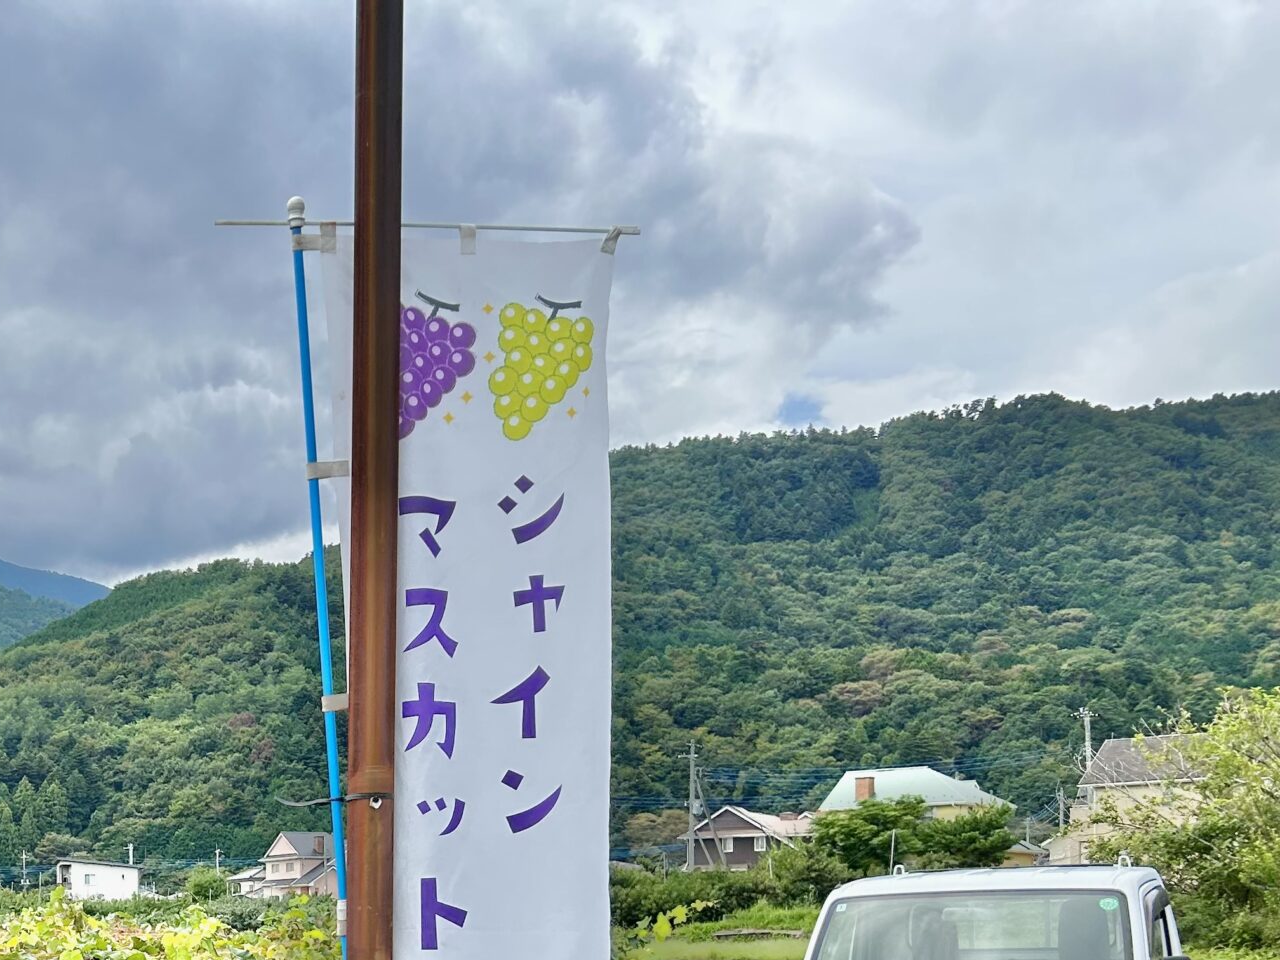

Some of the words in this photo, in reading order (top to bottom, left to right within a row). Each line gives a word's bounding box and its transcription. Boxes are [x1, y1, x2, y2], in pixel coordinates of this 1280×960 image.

[399, 495, 468, 950] マスカット
[490, 474, 565, 834] シャイン
